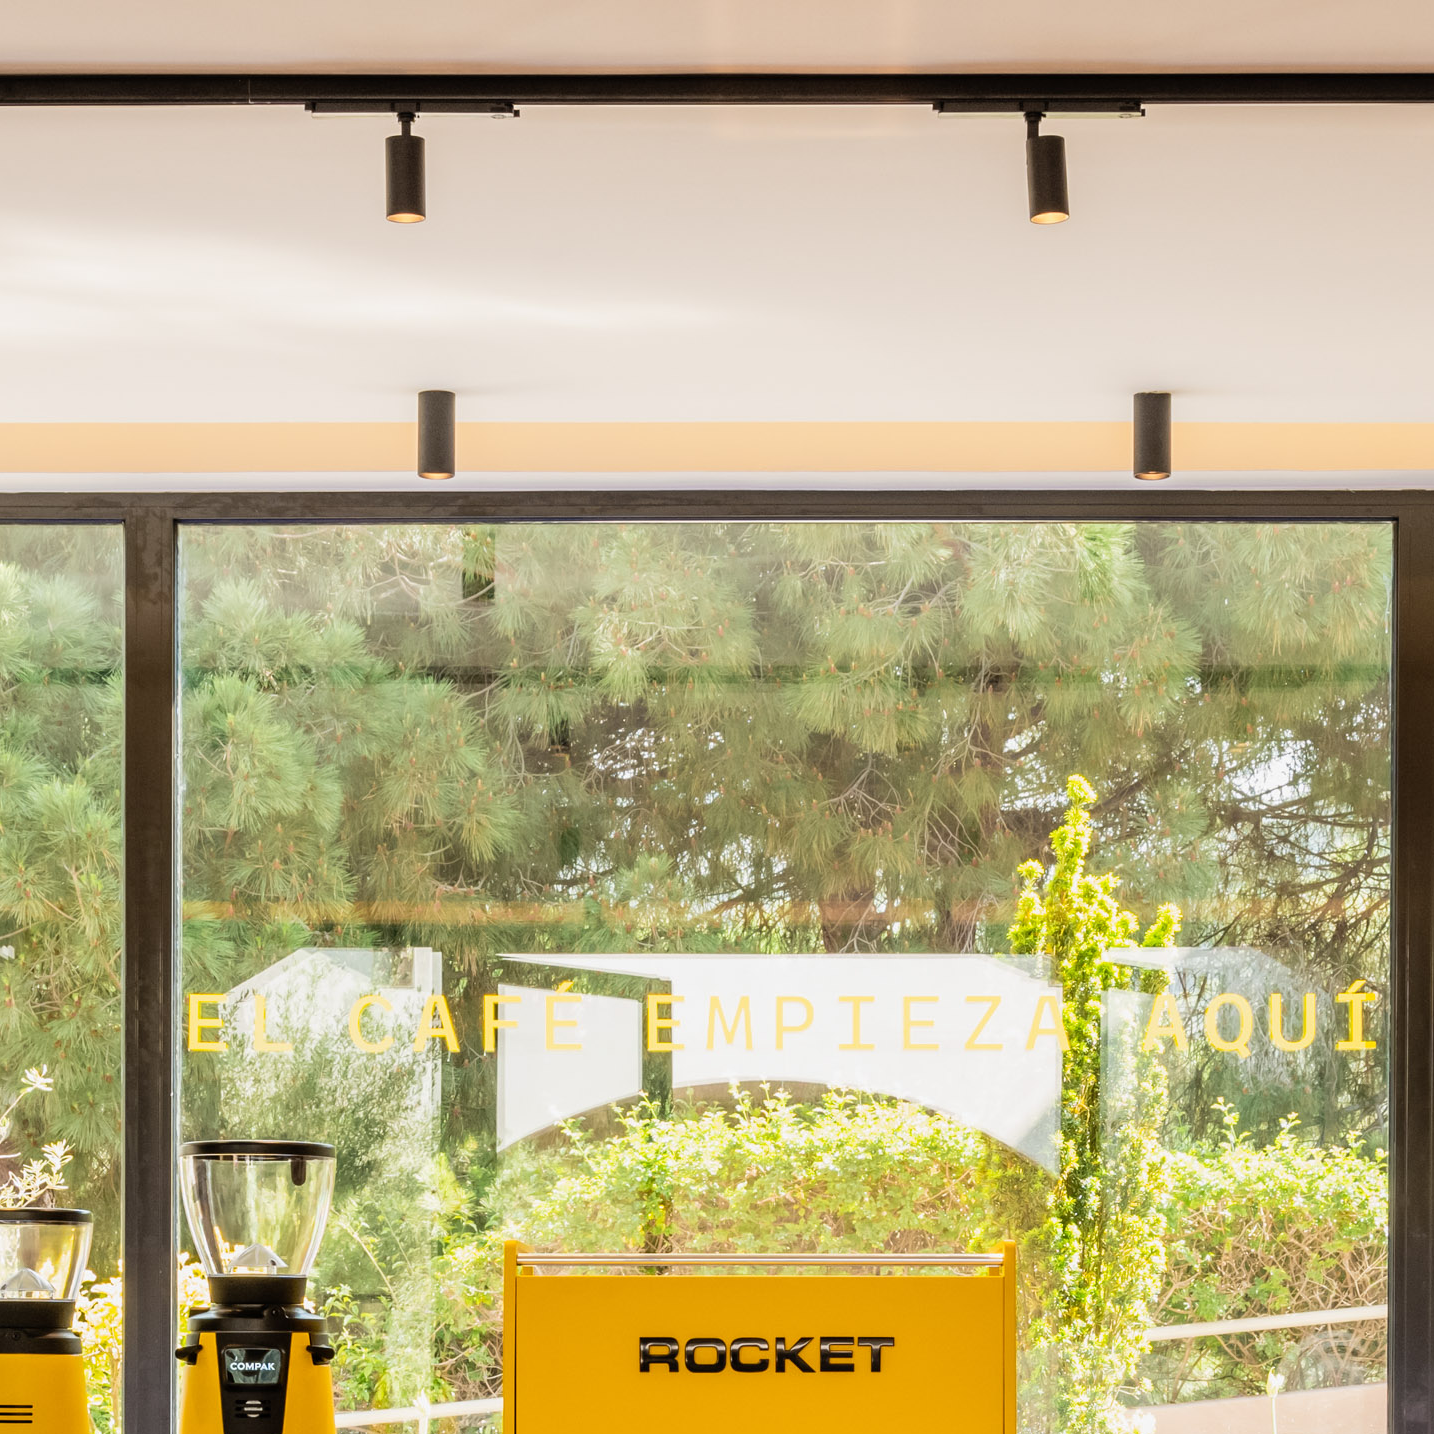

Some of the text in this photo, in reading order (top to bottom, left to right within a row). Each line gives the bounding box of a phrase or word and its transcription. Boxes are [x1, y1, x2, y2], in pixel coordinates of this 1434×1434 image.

[187, 979, 1379, 1059] EL CAFÉ EMPIEZA AQUÍ
[229, 1359, 276, 1371] COMPAK
[639, 1336, 895, 1374] ROCKET
